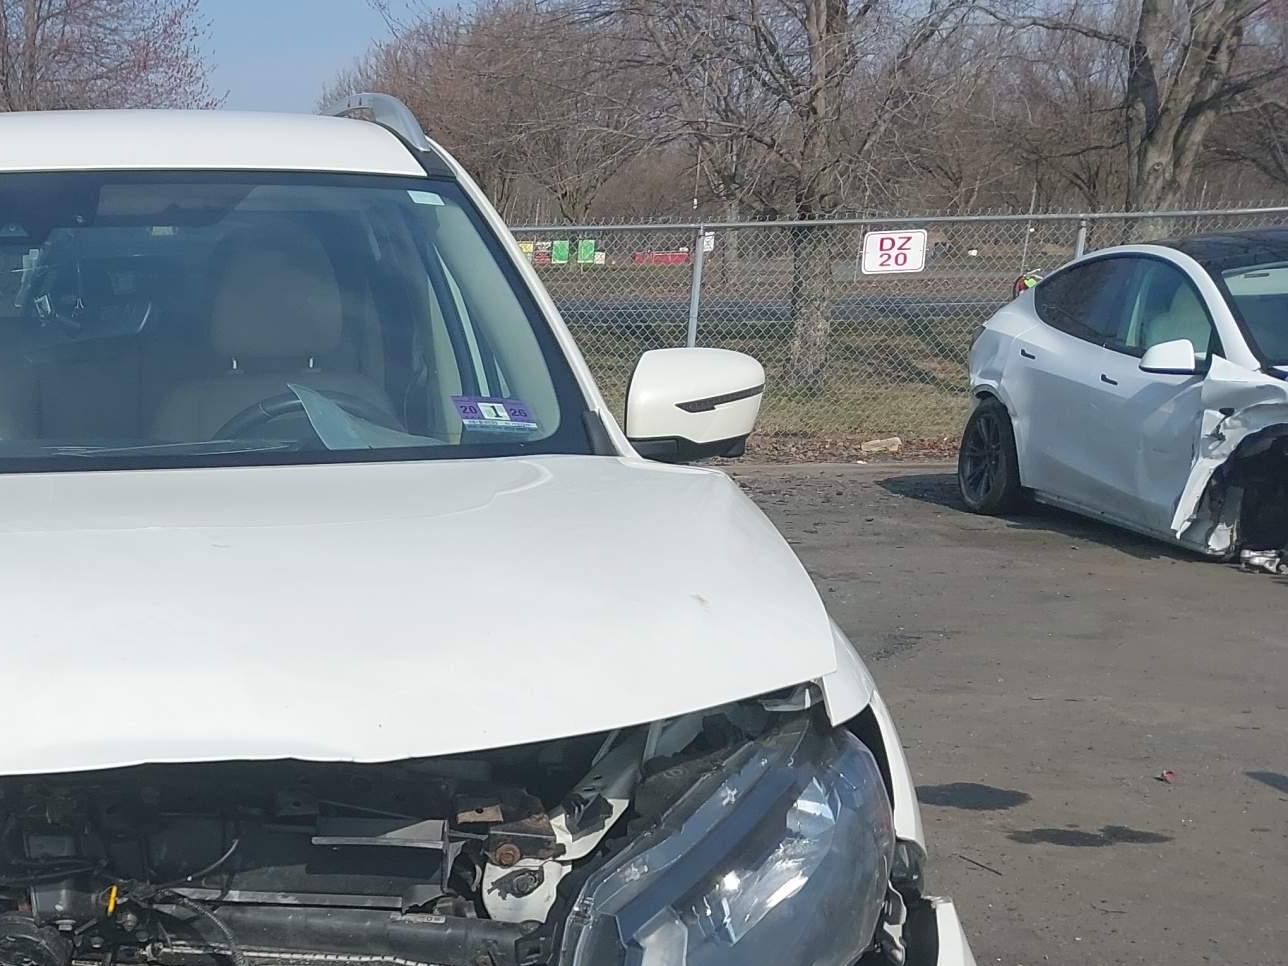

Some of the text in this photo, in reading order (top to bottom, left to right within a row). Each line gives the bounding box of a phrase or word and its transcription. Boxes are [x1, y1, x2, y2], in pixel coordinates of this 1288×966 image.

[879, 236, 912, 252] DZ
[879, 252, 907, 267] 20
[460, 405, 478, 414] 20
[491, 405, 502, 418] 1
